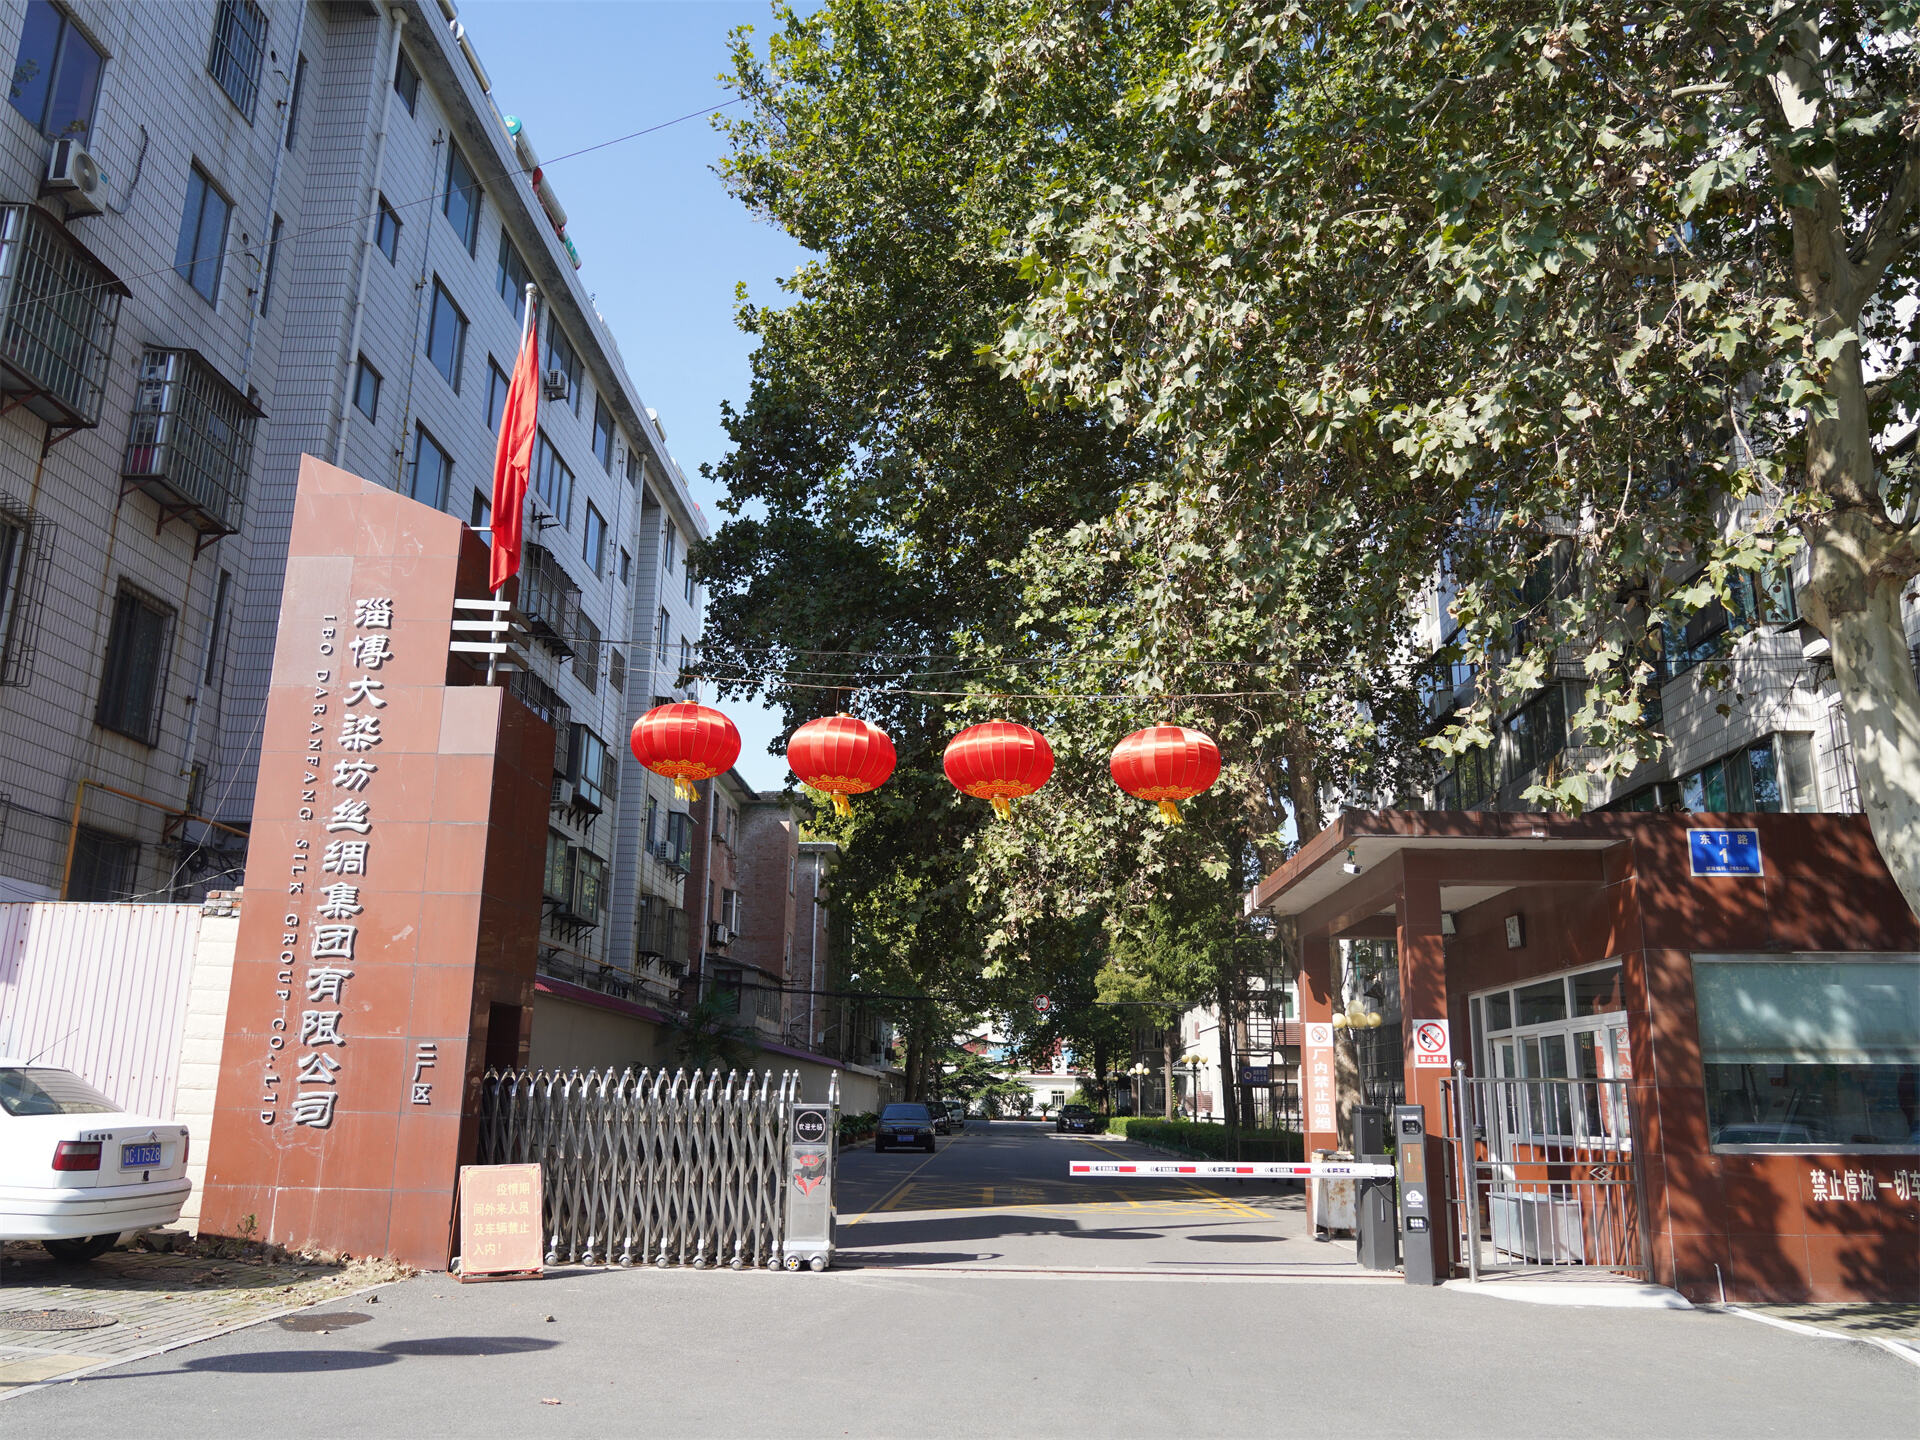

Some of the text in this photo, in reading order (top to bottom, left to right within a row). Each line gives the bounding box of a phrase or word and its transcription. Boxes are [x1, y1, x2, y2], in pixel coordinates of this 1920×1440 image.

[299, 670, 330, 822] DARANFANG
[288, 838, 310, 896] SILK
[292, 597, 393, 1129] 淄博大染坊丝绸集团有限公司
[1699, 834, 1748, 845] 东门路
[1718, 848, 1728, 864] 1
[275, 914, 299, 1001] GROUP
[411, 1043, 437, 1104] 二厂区
[1312, 1048, 1331, 1130] 厂内禁止吸烟
[472, 1200, 530, 1217] 间外来人员
[495, 1181, 531, 1196] 疫情期
[472, 1221, 531, 1237] 及车辆禁止
